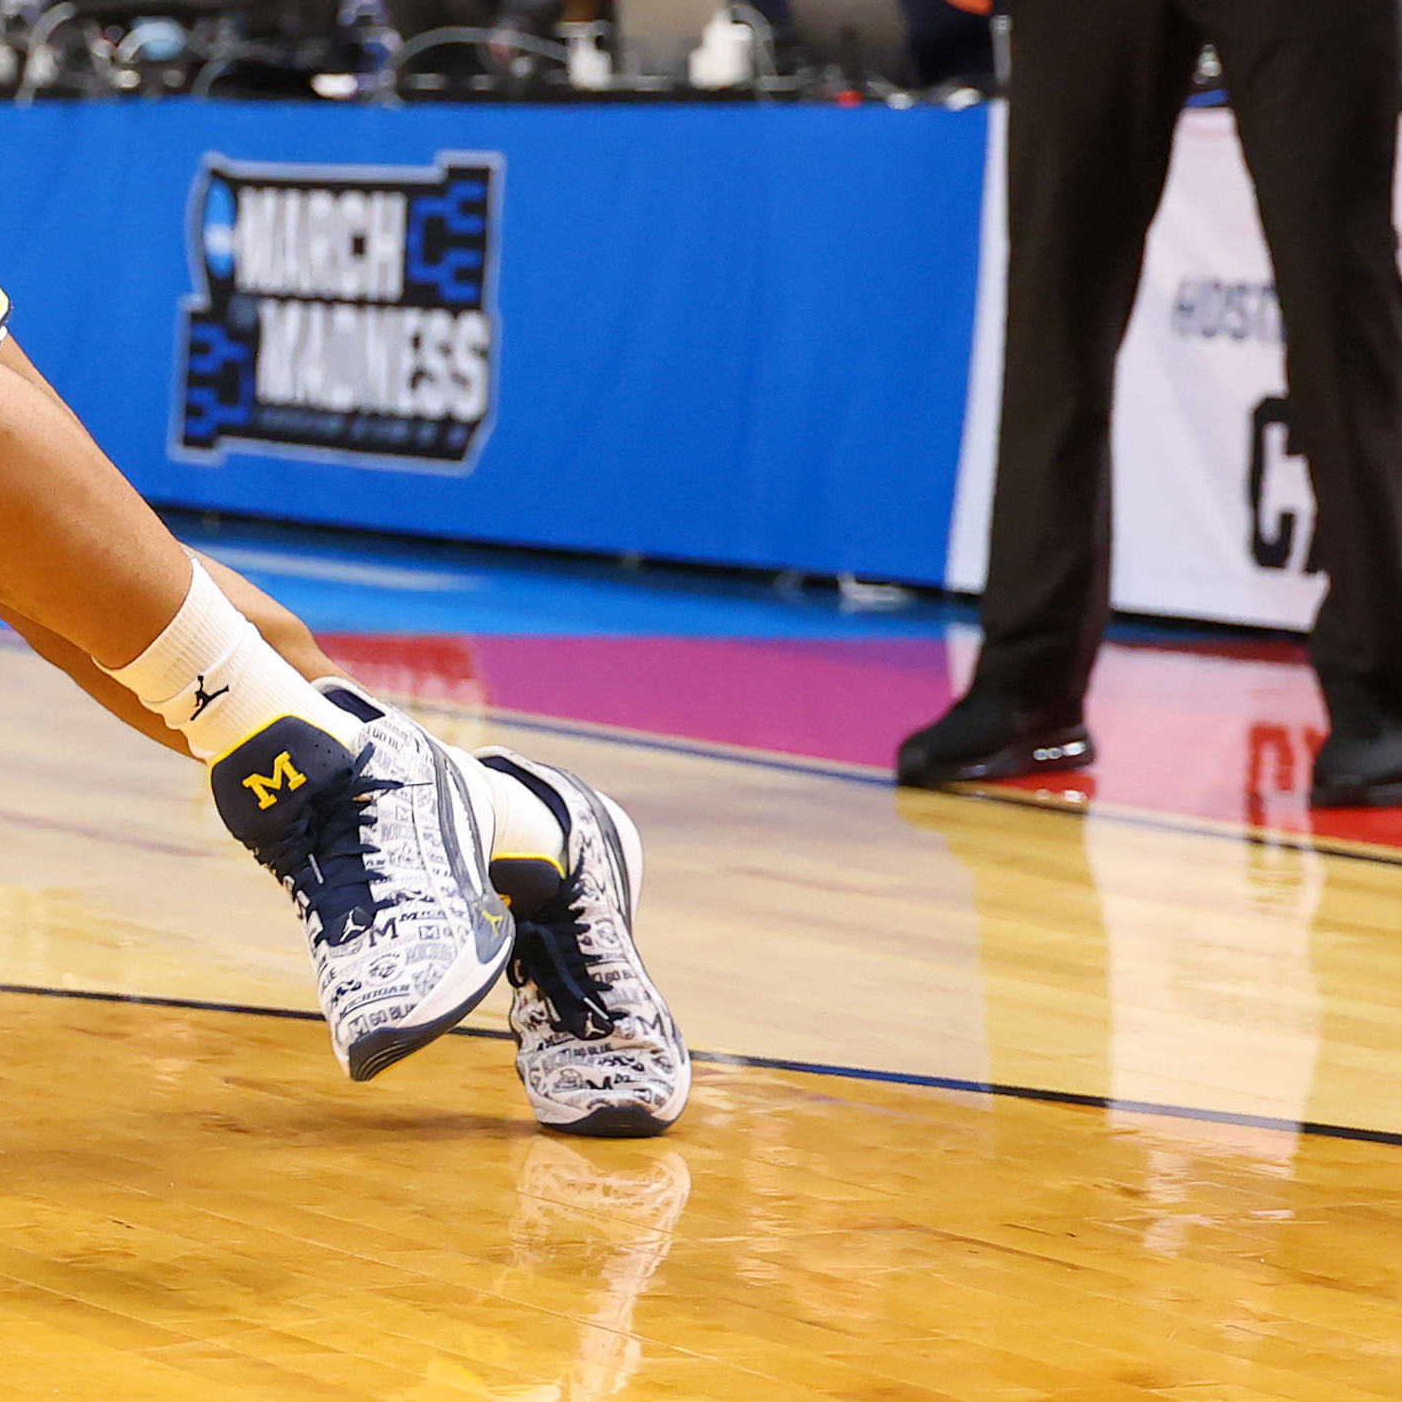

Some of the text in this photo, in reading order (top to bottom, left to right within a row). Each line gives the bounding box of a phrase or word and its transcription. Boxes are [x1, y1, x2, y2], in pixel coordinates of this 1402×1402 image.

[235, 185, 408, 302] MARCH
[254, 300, 490, 423] MADNESS
[242, 751, 307, 810] M
[370, 918, 399, 947] M
